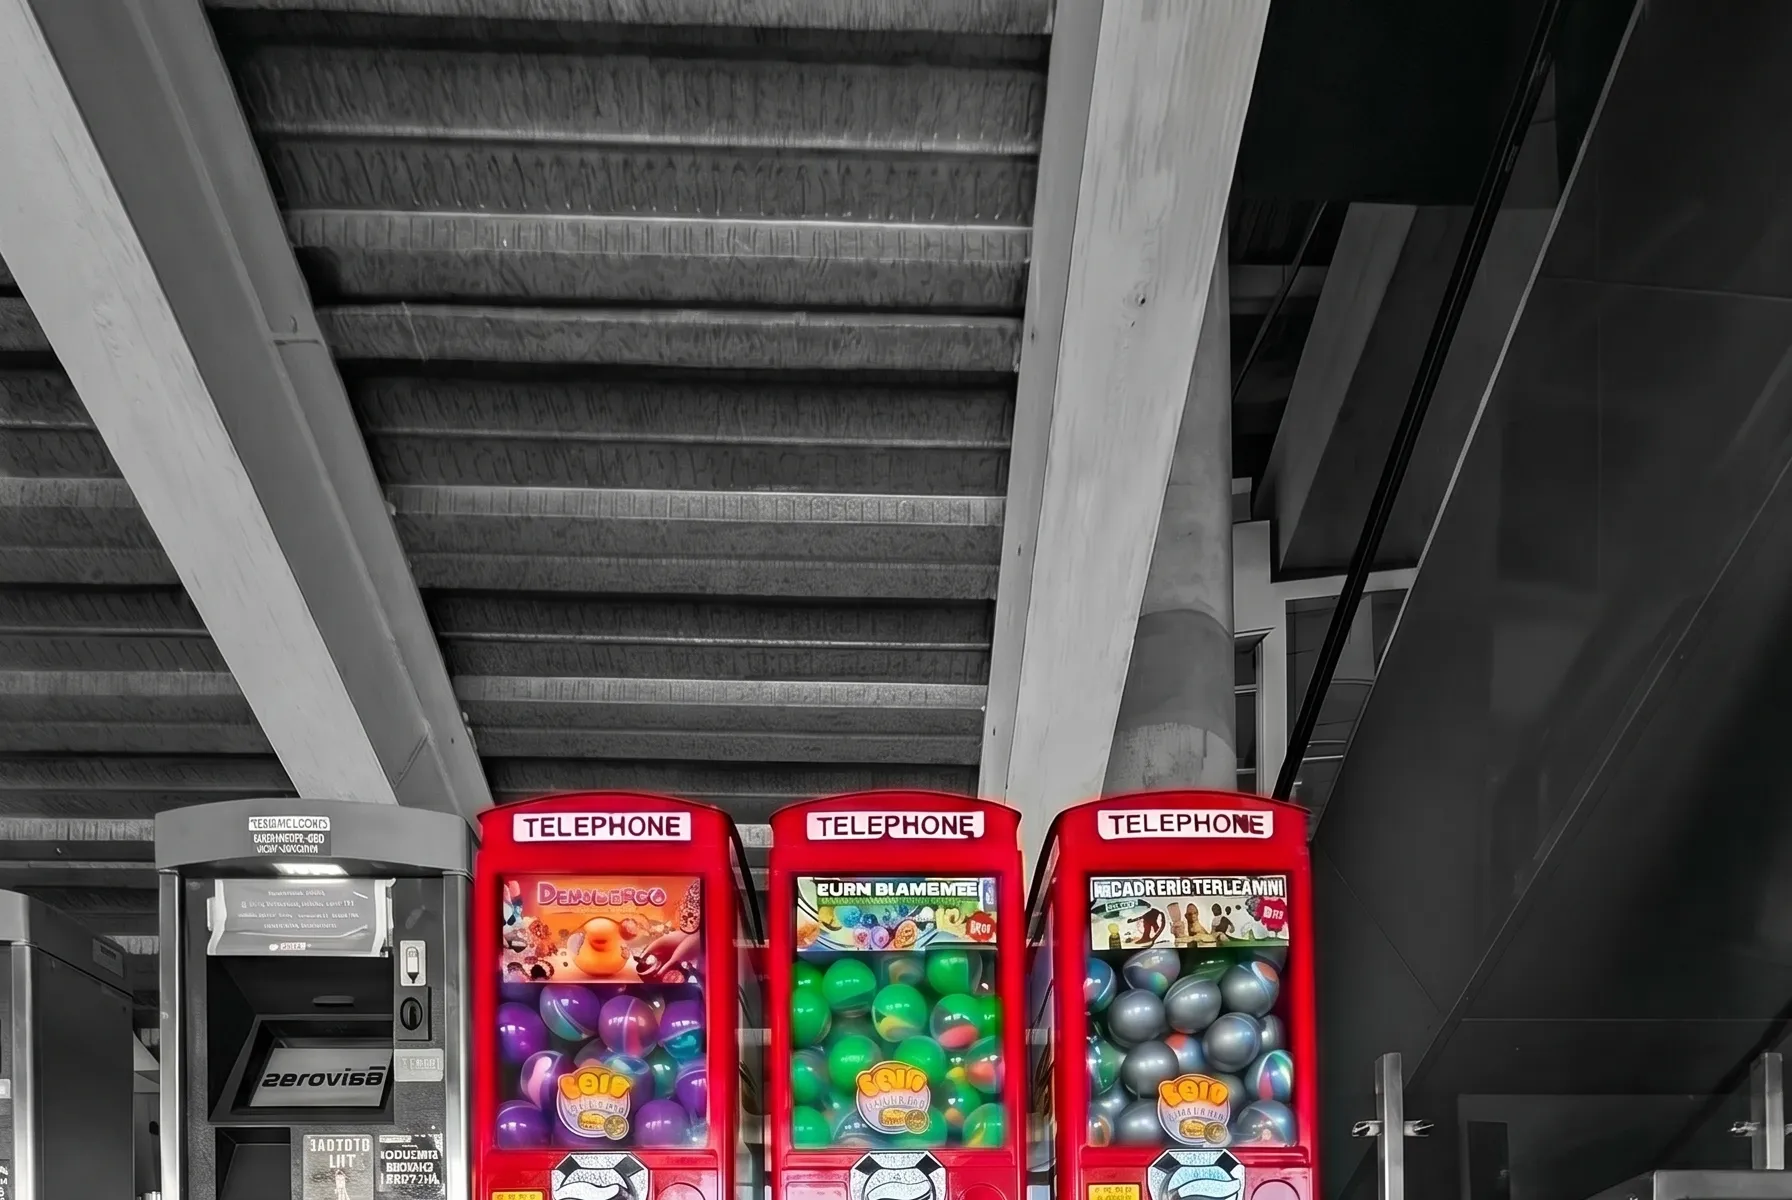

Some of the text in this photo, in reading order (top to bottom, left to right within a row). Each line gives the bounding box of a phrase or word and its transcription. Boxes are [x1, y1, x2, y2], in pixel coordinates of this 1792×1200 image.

[522, 816, 681, 837] TELEPHONE
[816, 815, 975, 837] TELEPHONE
[1108, 813, 1265, 836] TELEPHONE
